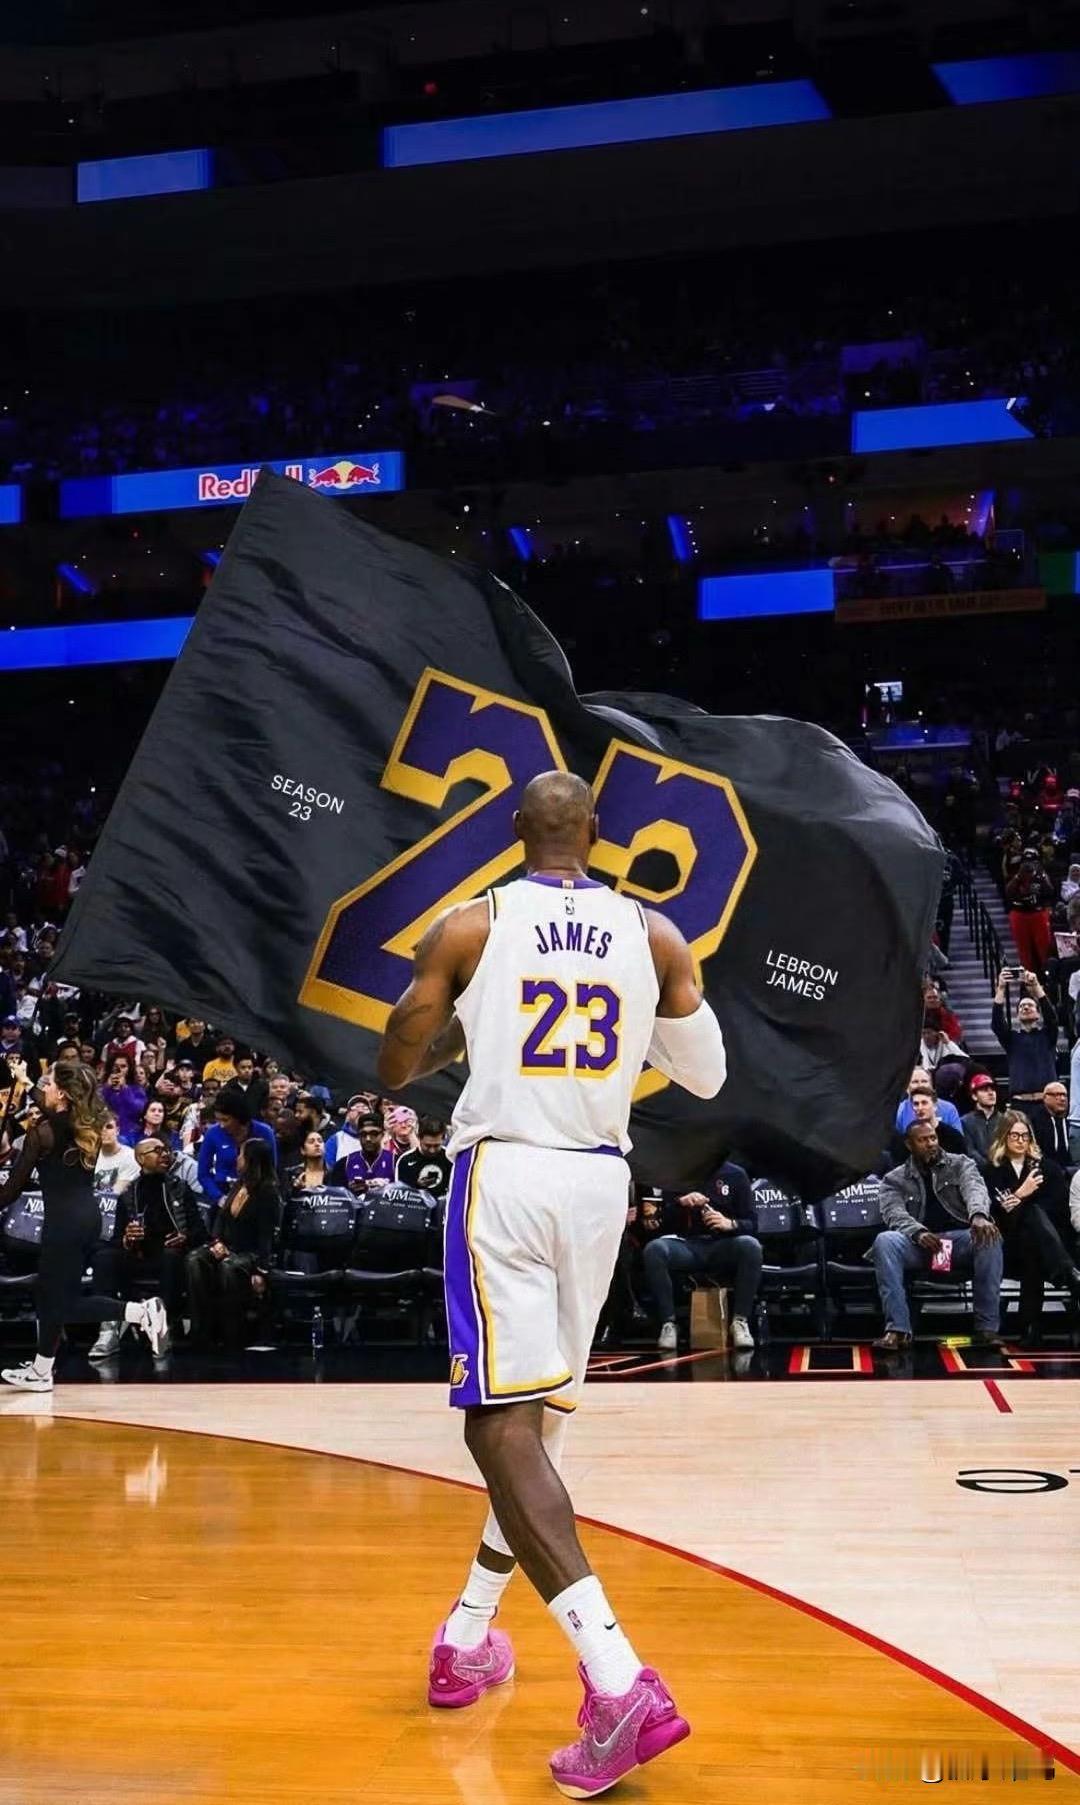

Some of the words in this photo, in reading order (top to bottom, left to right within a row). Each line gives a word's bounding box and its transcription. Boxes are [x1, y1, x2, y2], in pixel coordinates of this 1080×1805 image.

[199, 469, 251, 500] Red
[271, 774, 345, 815] SEASON
[288, 802, 312, 821] 23
[535, 921, 613, 959] JAMES
[766, 949, 839, 986] LEBRON
[766, 970, 826, 1001] JAMES
[519, 976, 624, 1081] 23
[302, 1195, 329, 1209] NJM
[382, 1188, 409, 1202] NJM
[754, 1189, 783, 1204] NJM
[835, 1183, 864, 1199] JM
